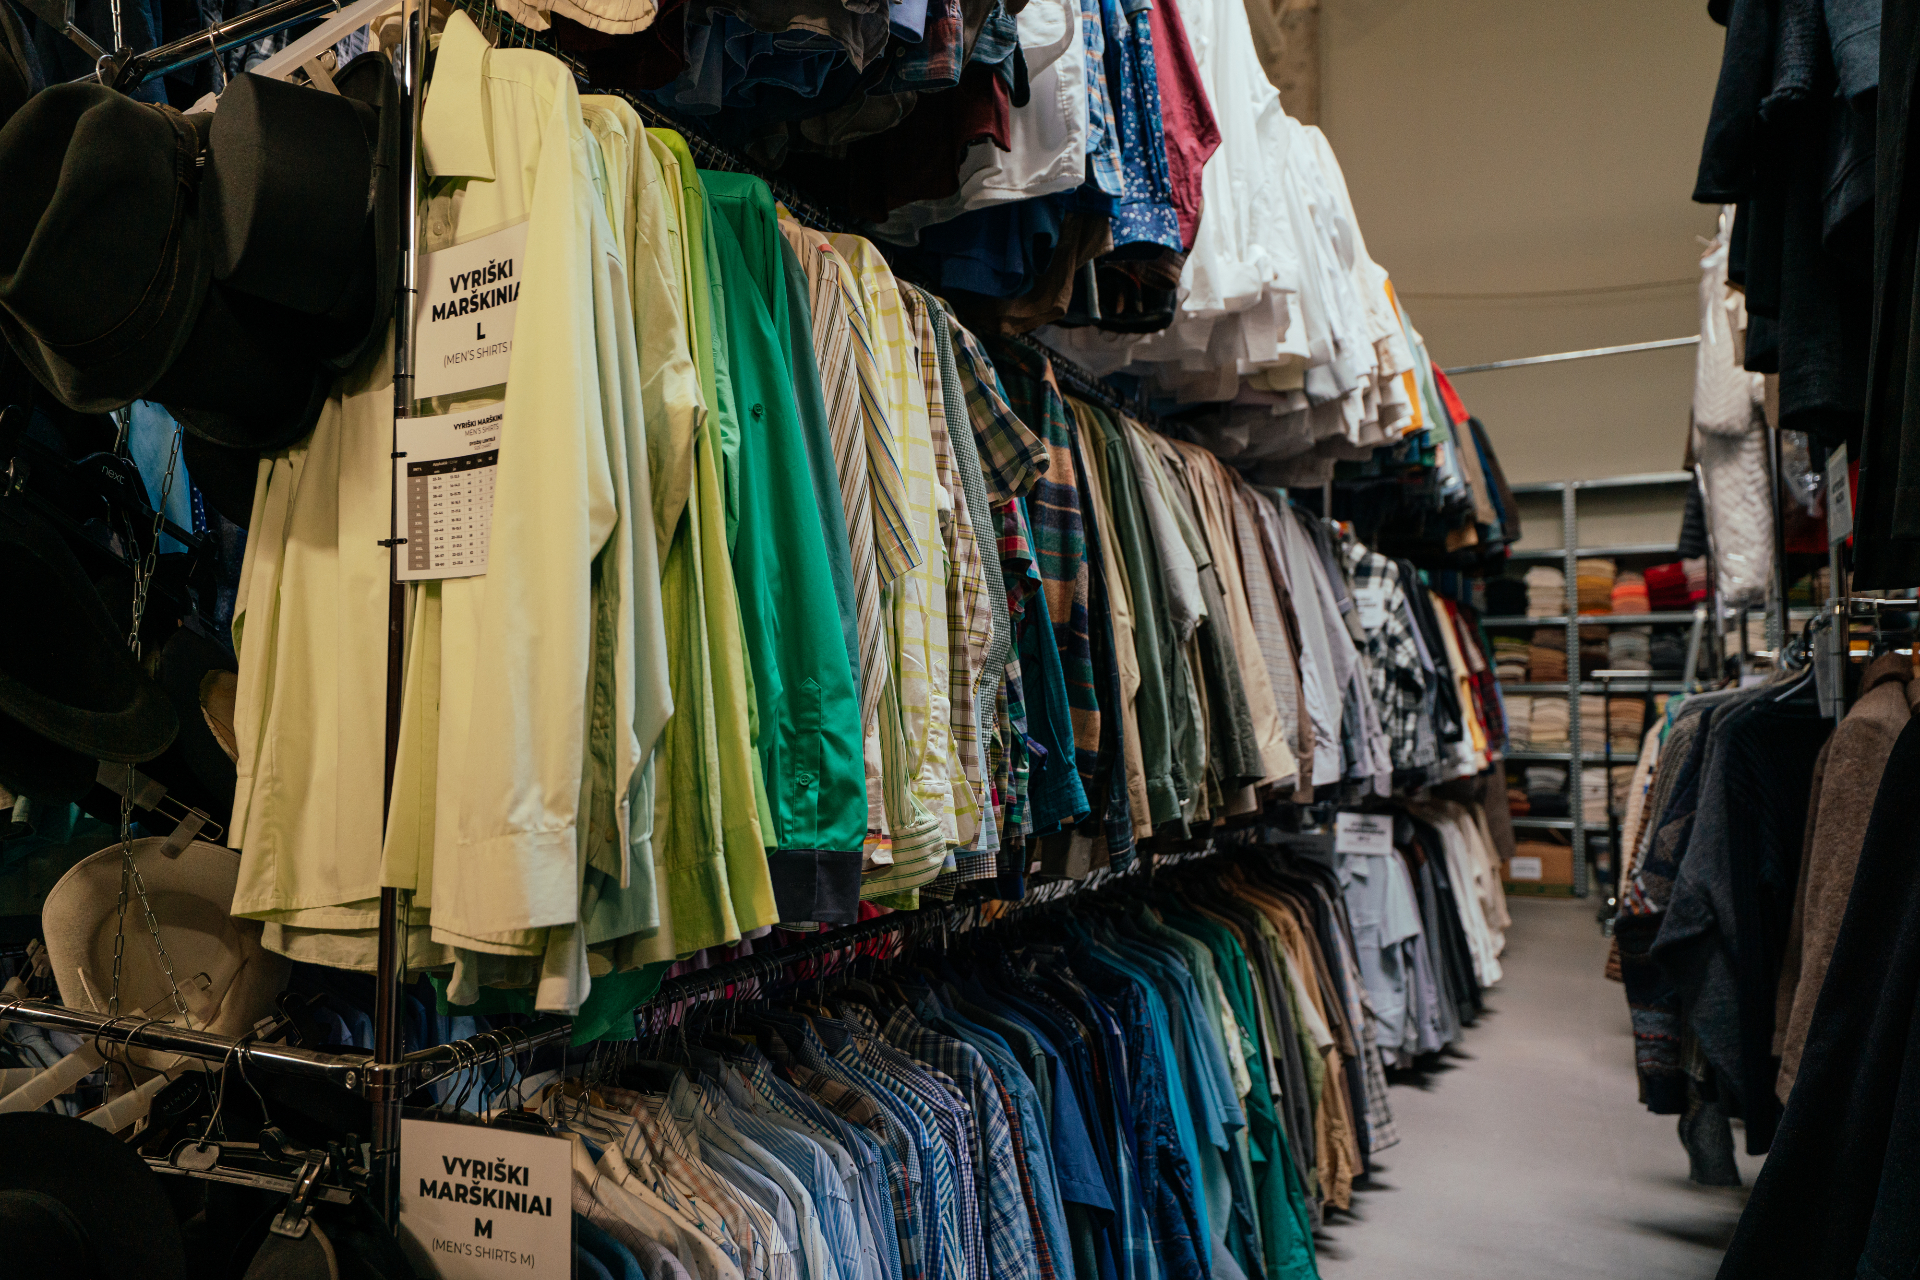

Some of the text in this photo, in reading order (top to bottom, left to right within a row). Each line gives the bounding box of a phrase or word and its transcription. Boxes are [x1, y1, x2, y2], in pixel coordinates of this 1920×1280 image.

[449, 258, 513, 294] VYRIŠKI
[476, 322, 486, 341] L
[443, 349, 475, 368] (MEN'S
[476, 341, 508, 359] SHIRTS
[101, 465, 125, 485] next
[442, 1155, 530, 1187] VYRIŠKI
[419, 1178, 552, 1217] MARŠKINIAI
[474, 1217, 493, 1239] M
[432, 1237, 535, 1269] (MEN'S SHIRTS M)
